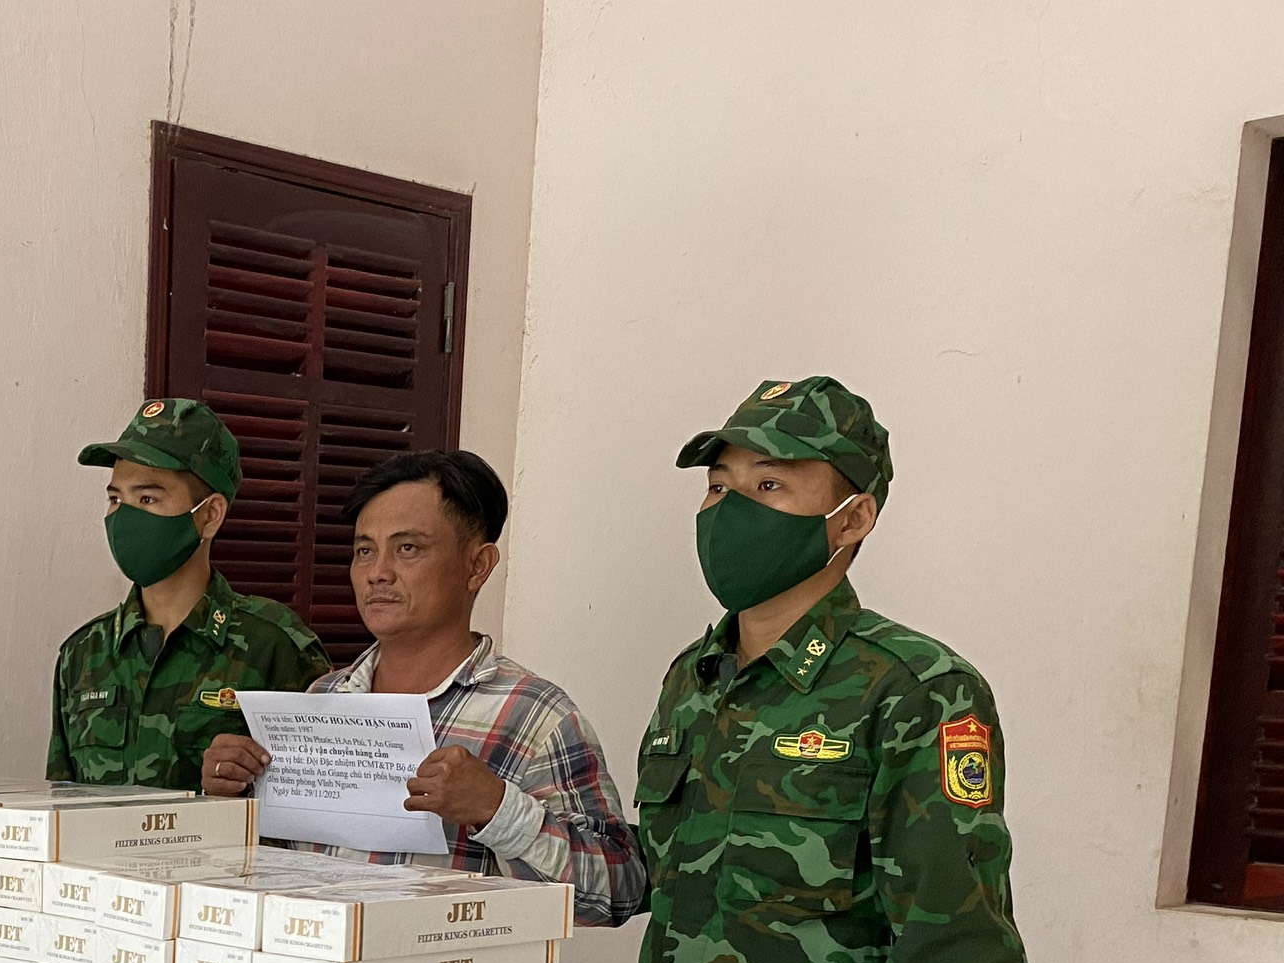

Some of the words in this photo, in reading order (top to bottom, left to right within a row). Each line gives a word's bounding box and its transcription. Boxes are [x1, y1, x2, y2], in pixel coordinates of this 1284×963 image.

[387, 720, 412, 730] (nam)
[141, 812, 177, 832] JET
[1, 825, 32, 842] JET
[115, 839, 138, 848] FILTER
[139, 837, 161, 847] KINGS
[161, 834, 203, 845] CIGARETTES
[112, 894, 146, 916] JET
[447, 900, 486, 923] JET
[197, 905, 235, 927] JET
[284, 916, 324, 939] JET
[417, 933, 443, 943] FILTER
[444, 930, 468, 940] KINGS
[469, 926, 513, 938] CIGARETTES
